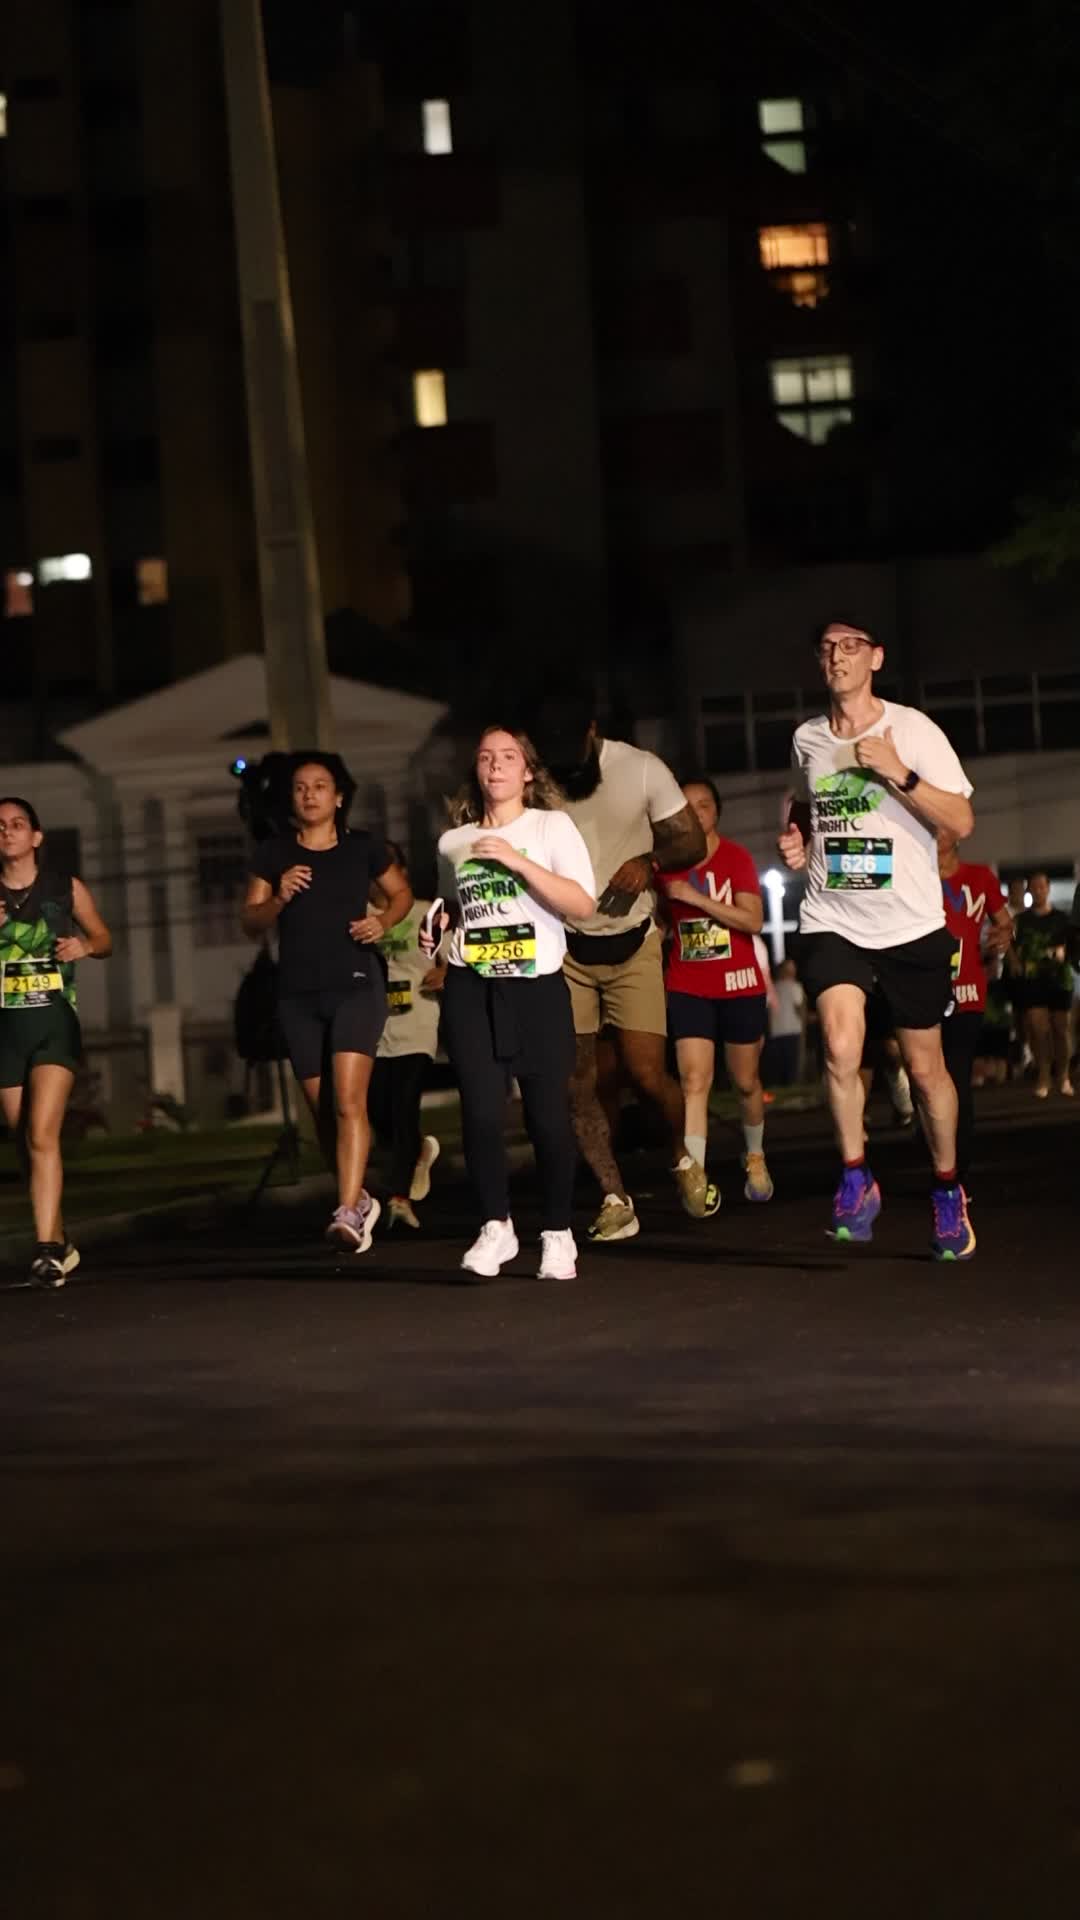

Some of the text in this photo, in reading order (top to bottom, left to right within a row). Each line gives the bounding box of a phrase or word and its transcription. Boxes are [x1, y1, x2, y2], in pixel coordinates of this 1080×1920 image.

[818, 819, 847, 833] NIGHT
[841, 854, 876, 873] 626
[460, 880, 517, 906] INSPIRA
[465, 902, 494, 922] NIGHT
[477, 941, 524, 961] 2256
[13, 975, 50, 991] 2149
[725, 968, 758, 991] RUN
[952, 984, 979, 1003] UN
